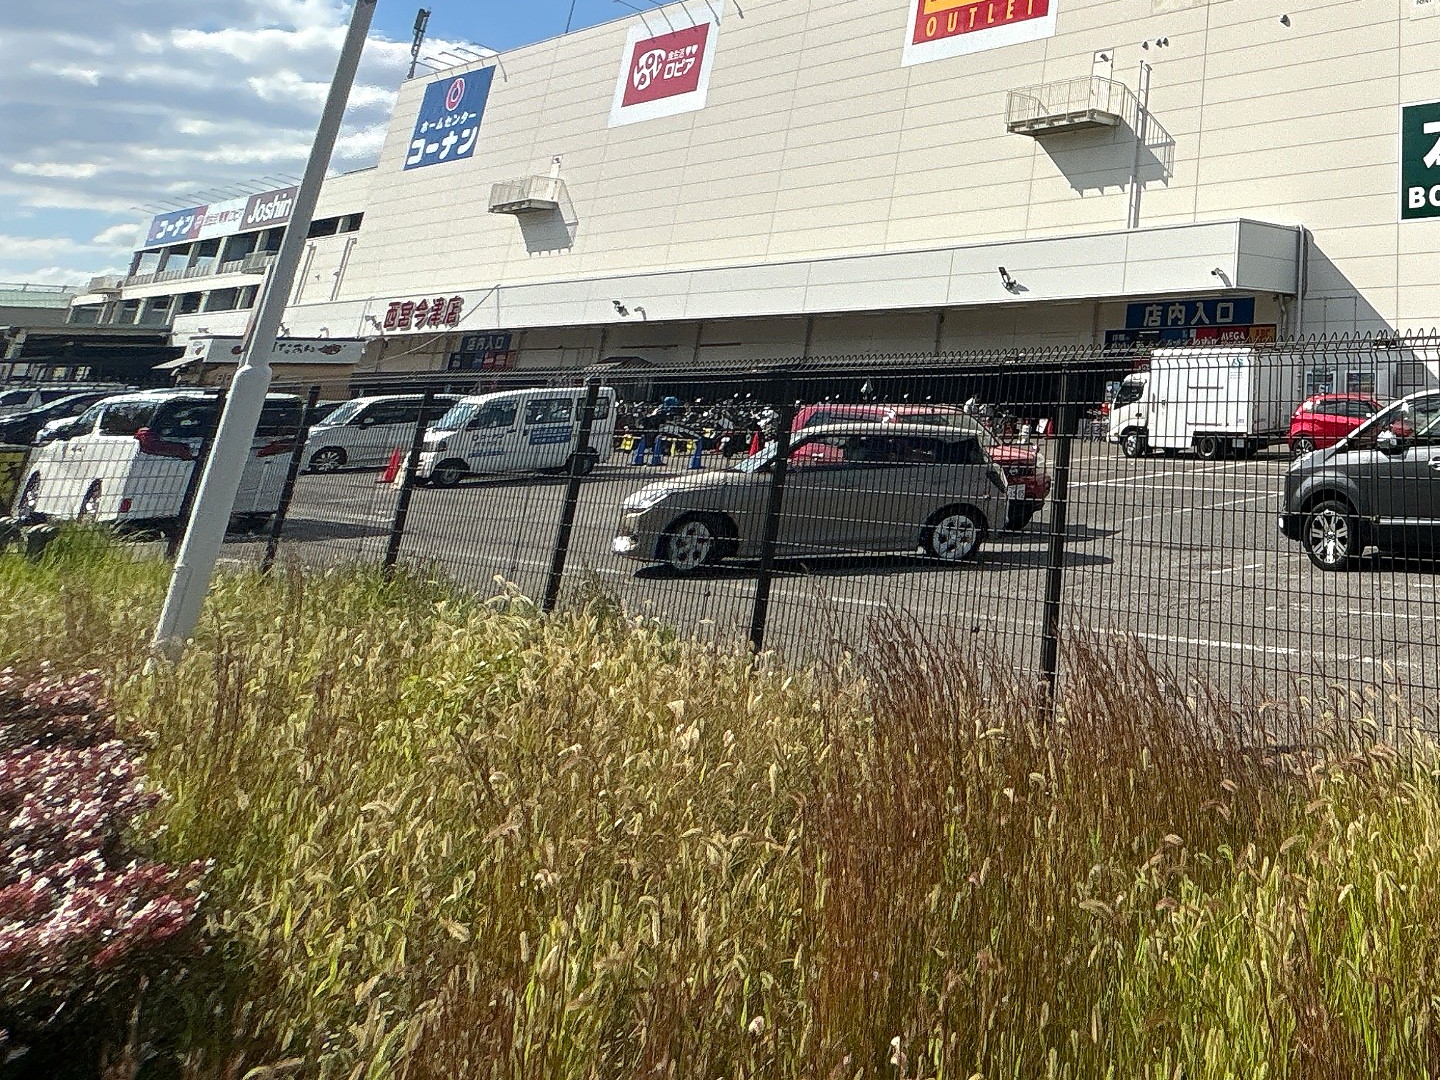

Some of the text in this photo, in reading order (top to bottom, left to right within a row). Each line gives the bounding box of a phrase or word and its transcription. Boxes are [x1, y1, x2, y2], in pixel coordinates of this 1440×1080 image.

[663, 57, 696, 80] ロピア
[420, 111, 477, 134] ホームセンター
[406, 126, 478, 165] コーナン
[247, 193, 293, 224] Joshin
[156, 215, 195, 239] コーナン
[1142, 301, 1234, 327] 店内入口
